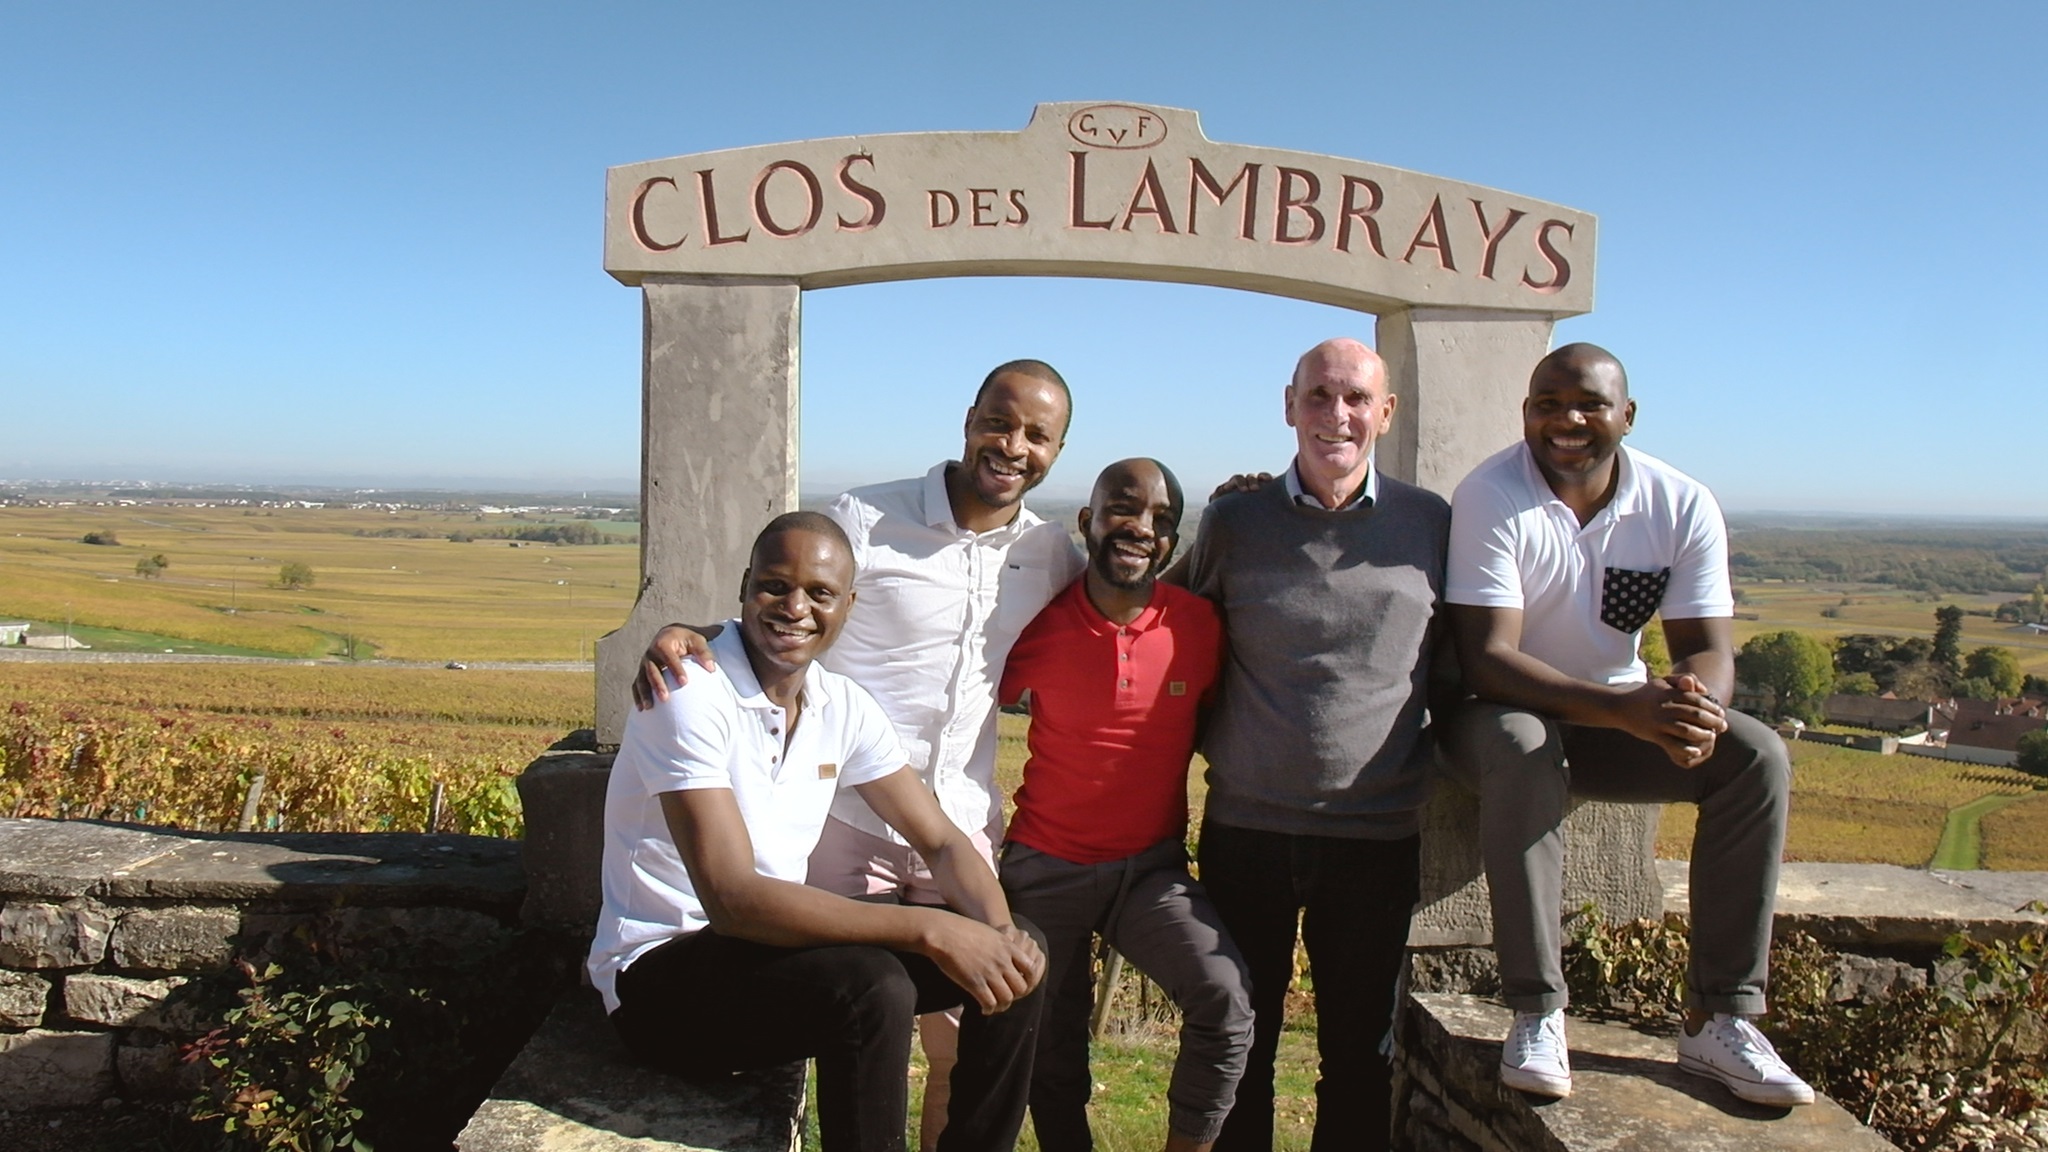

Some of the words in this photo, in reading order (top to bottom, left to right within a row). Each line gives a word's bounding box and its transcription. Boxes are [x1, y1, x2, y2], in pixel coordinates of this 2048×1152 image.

[628, 152, 887, 254] CLOS
[927, 188, 1030, 230] DES
[1066, 150, 1575, 294] LAMBRAYS
